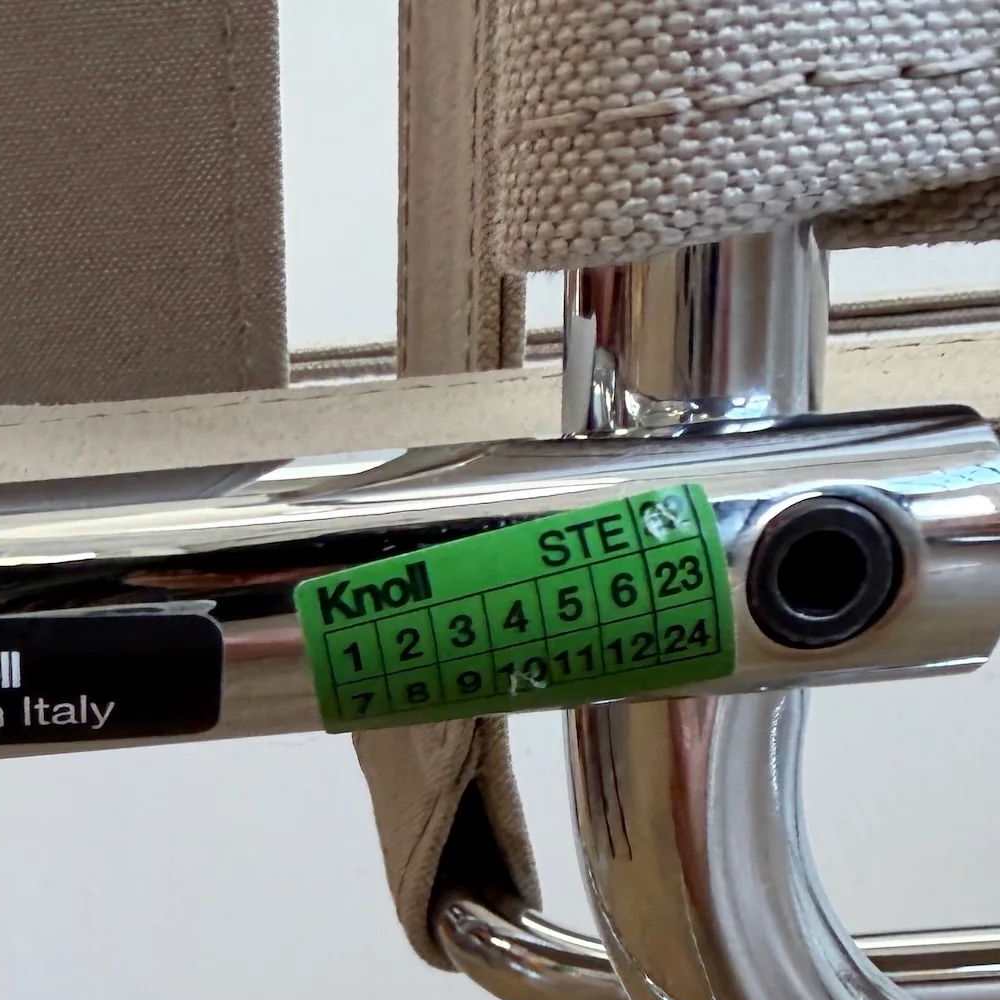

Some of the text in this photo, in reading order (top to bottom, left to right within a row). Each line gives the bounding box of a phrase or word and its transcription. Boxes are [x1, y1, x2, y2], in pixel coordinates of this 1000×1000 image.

[317, 560, 432, 625] Knoll
[538, 514, 630, 566] STE
[343, 555, 703, 672] 1 2 3 4 5 6 23
[23, 694, 116, 730] Italy
[351, 618, 712, 715] 7 8 9 10 11 12 24
